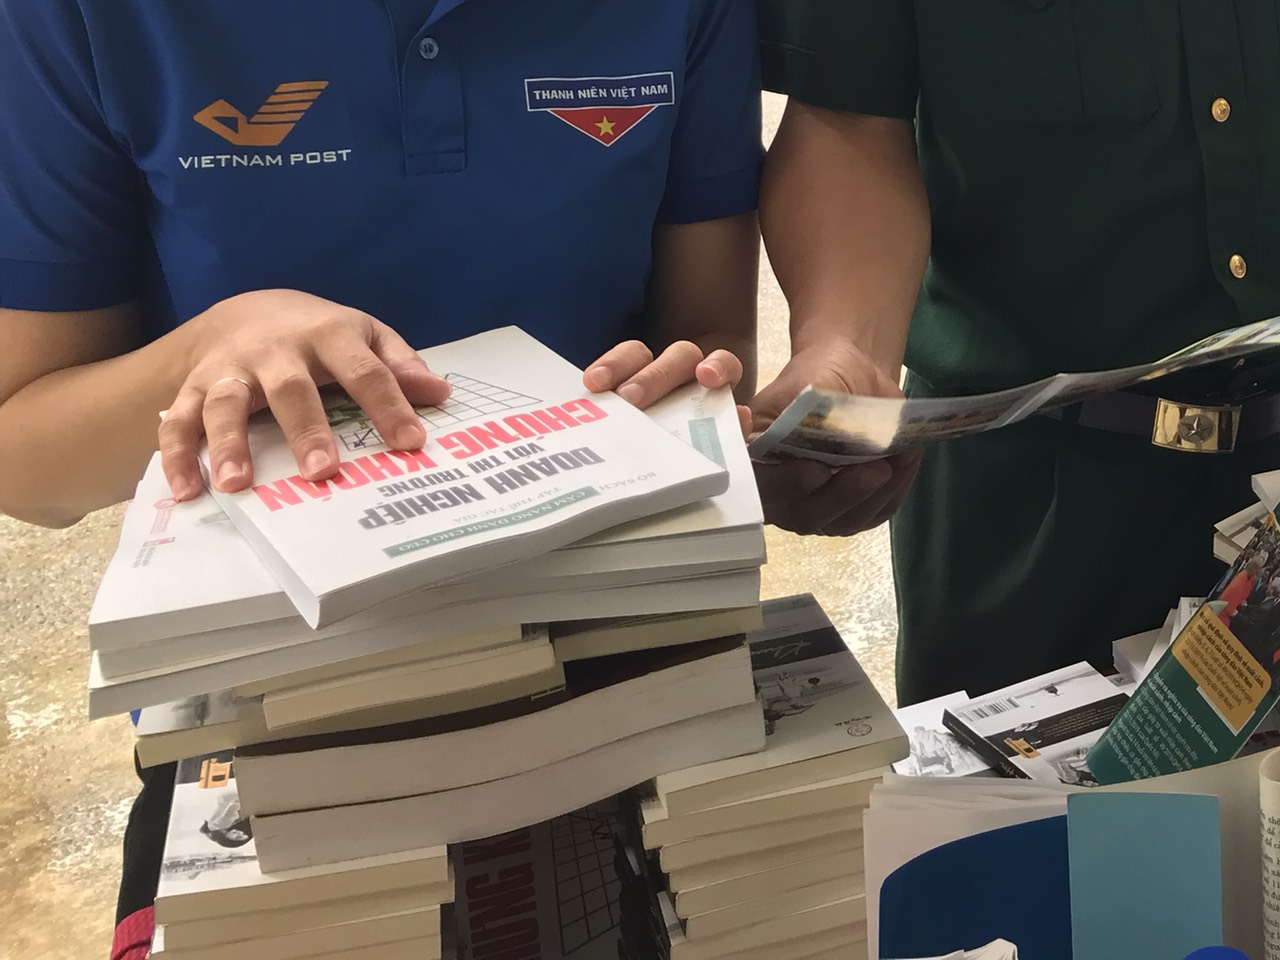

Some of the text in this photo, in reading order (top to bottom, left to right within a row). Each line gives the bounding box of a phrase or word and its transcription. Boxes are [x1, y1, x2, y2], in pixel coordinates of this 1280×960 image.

[532, 83, 668, 102] THANH NIÊN VIỆT NAM
[177, 148, 350, 173] VIETNAM POST
[434, 396, 609, 460] CHỨNG
[353, 445, 606, 530] DOANH NGHIỆP
[375, 465, 466, 498] TRƯỜNG
